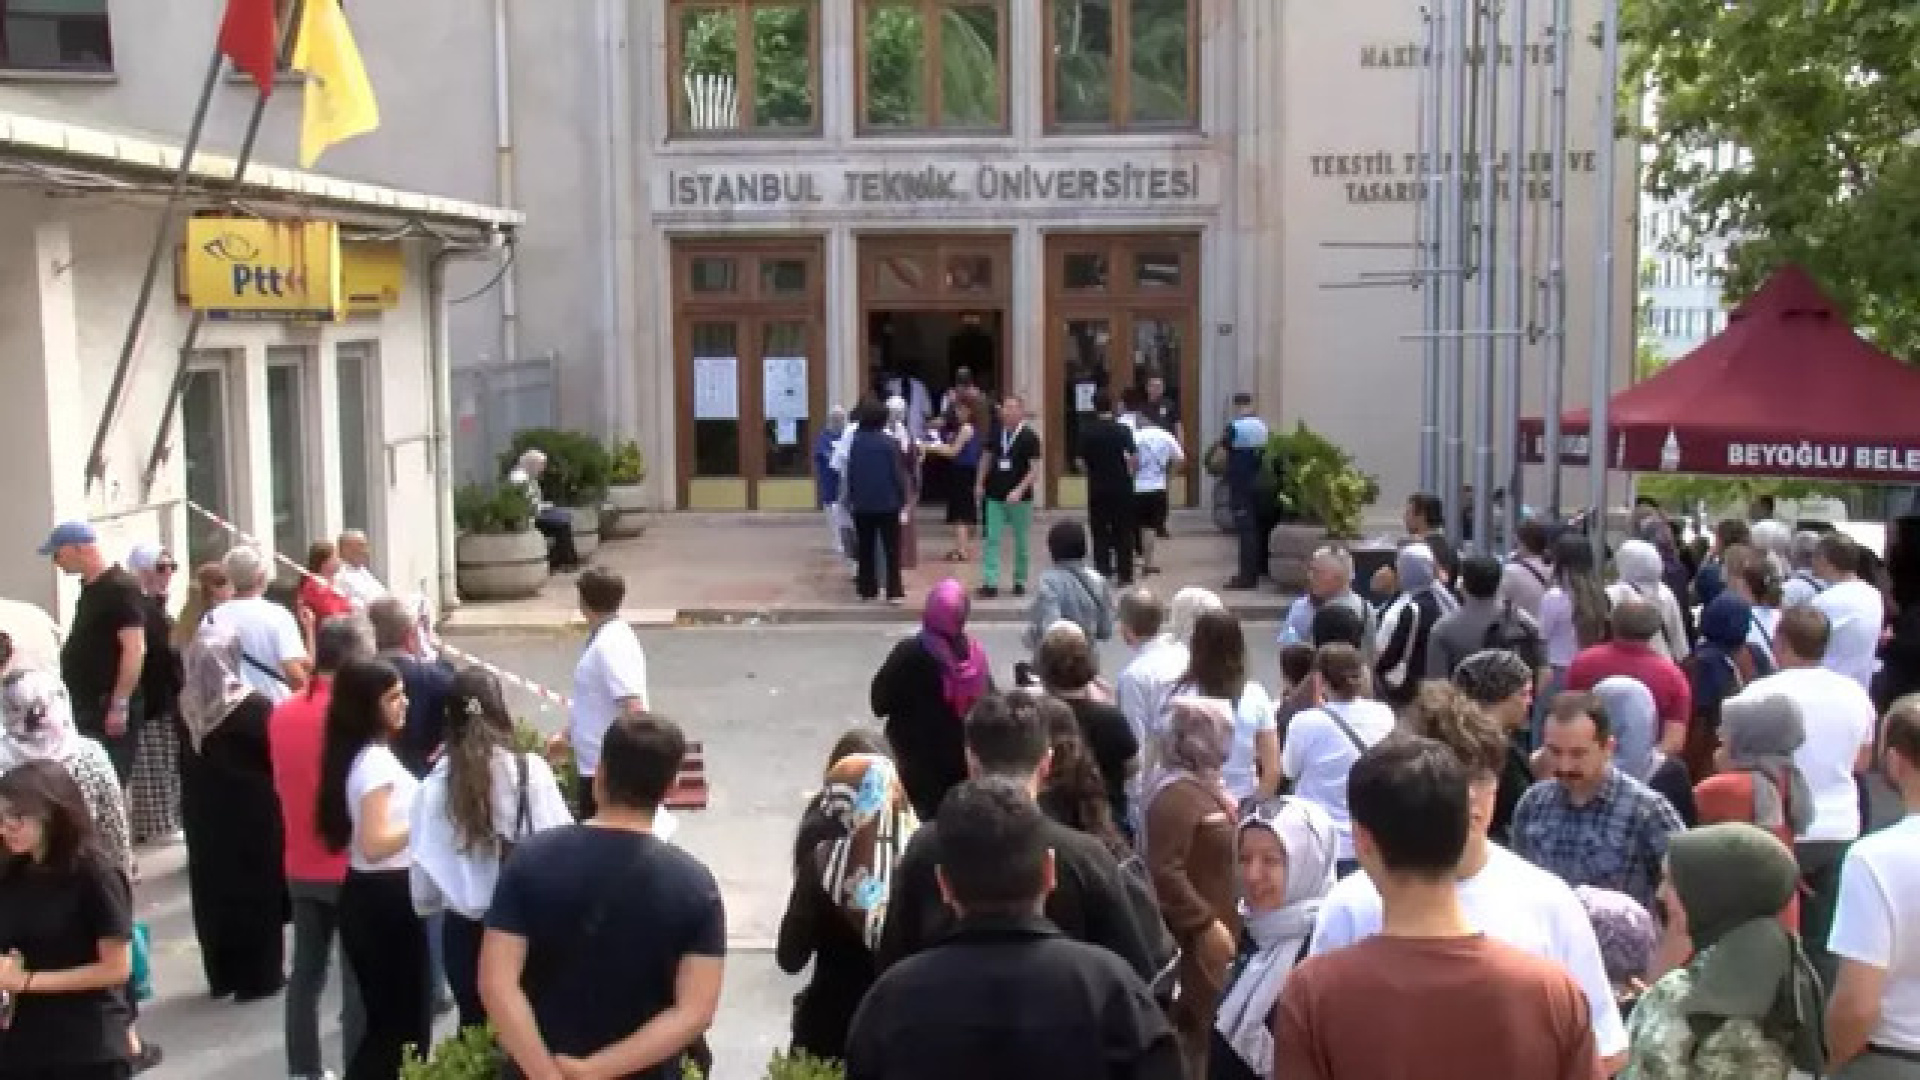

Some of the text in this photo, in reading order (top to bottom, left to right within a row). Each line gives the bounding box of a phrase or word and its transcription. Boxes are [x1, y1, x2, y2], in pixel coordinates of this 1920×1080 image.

[1310, 150, 1395, 174] TEKSTİL
[1568, 151, 1597, 172] VE
[669, 162, 1200, 206] İSTANBUL TEKNİK ÜNİVERSİTESİ
[1728, 441, 1920, 472] BEYOĞLU BELE
